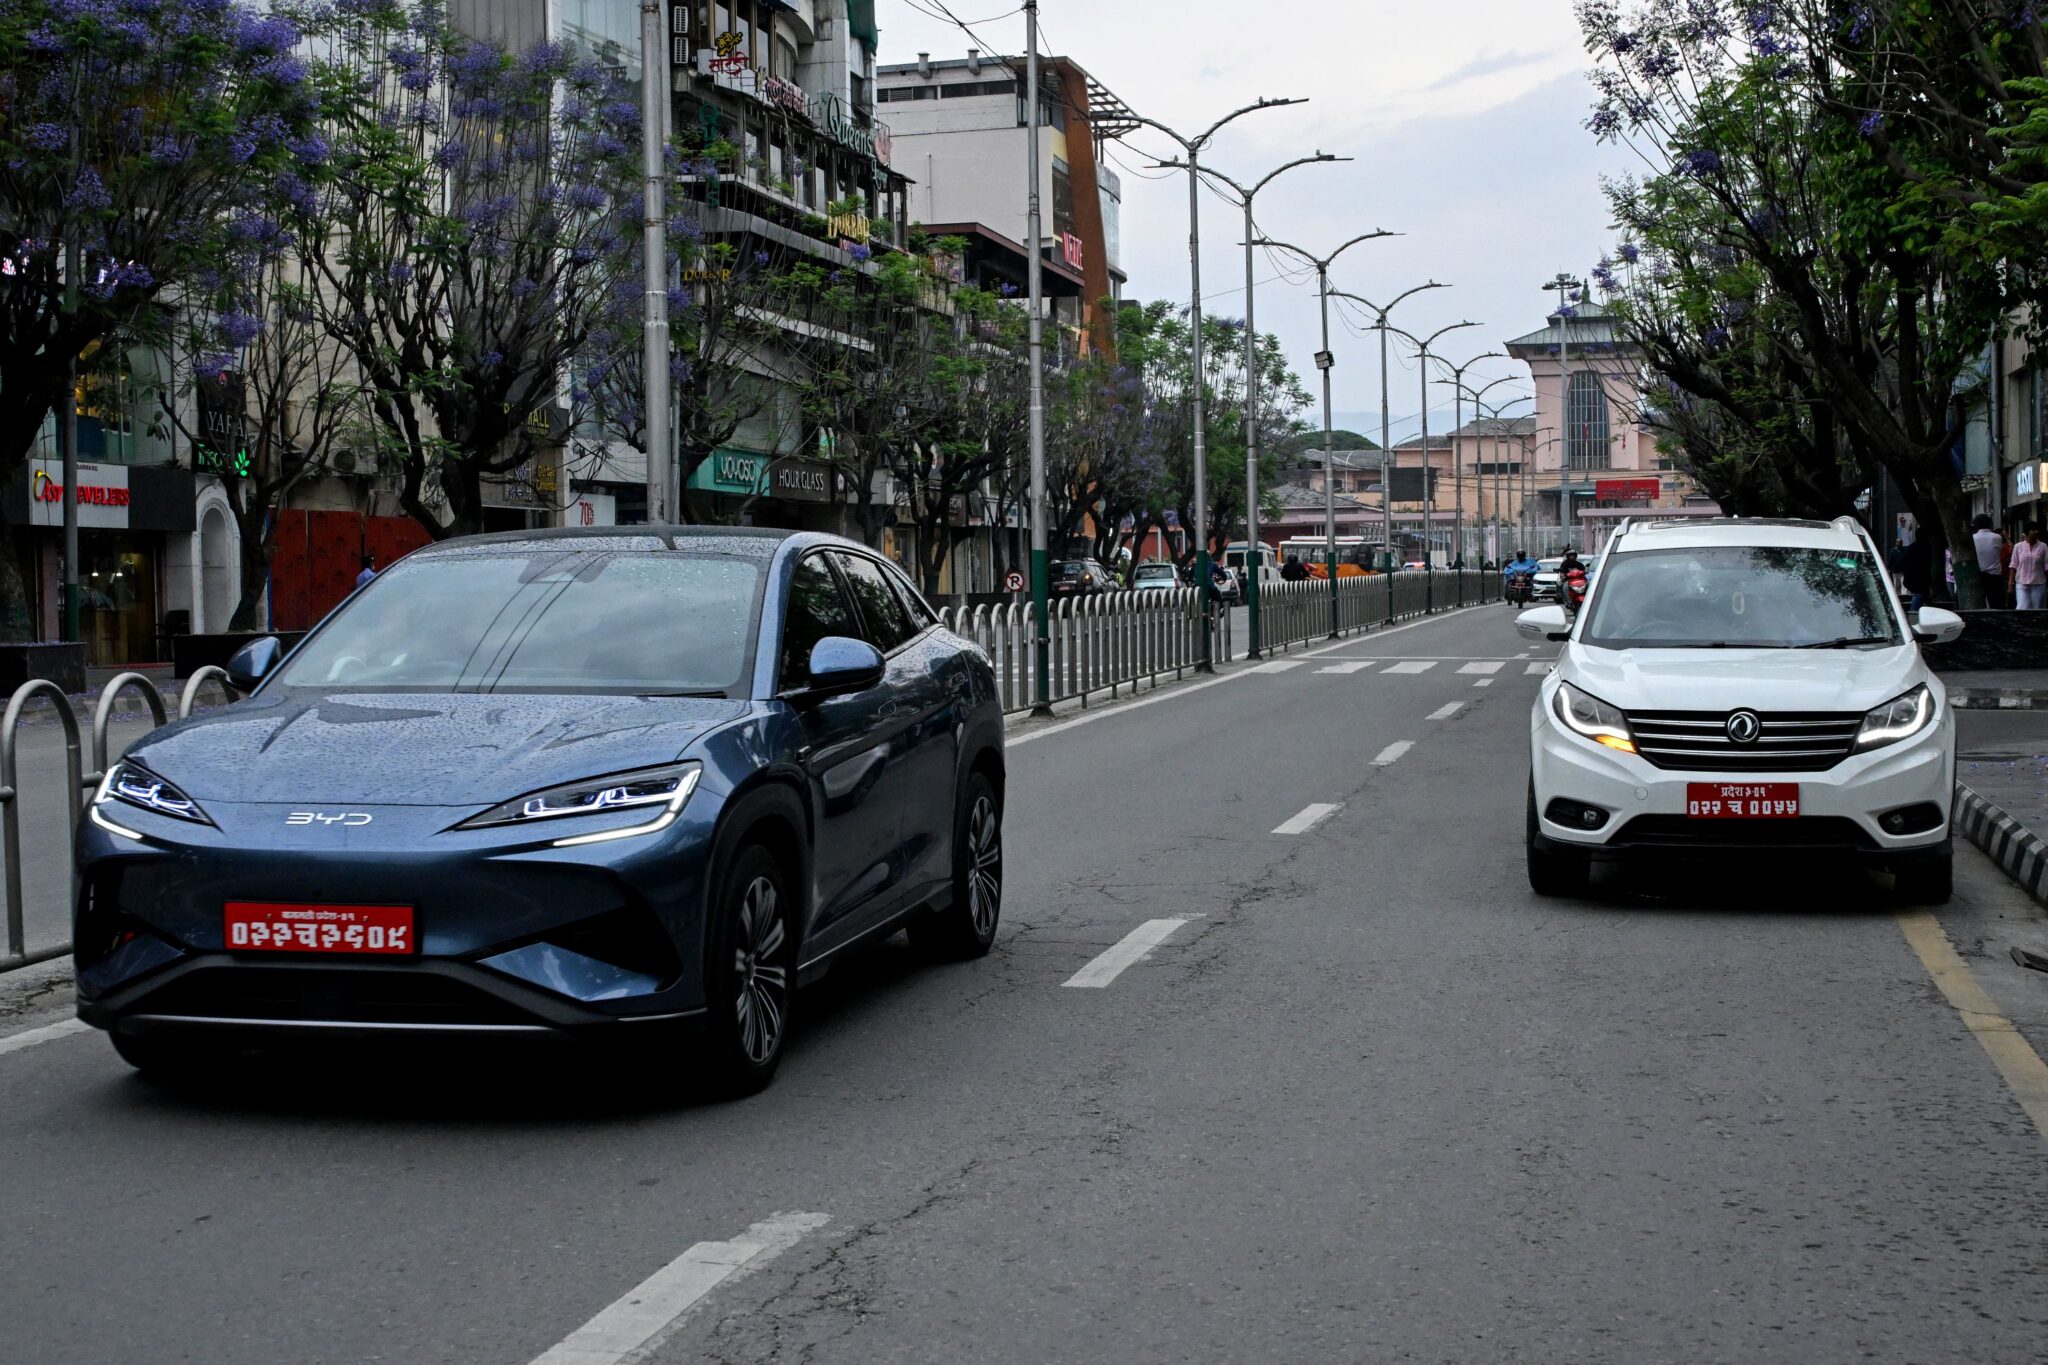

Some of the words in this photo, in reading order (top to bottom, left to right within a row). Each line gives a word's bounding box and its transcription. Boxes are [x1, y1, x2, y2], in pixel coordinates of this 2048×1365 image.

[779, 469, 799, 488] HOUR
[801, 471, 824, 491] GLASS
[1721, 785, 1743, 798] प्रदेश
[285, 812, 372, 826] BYD
